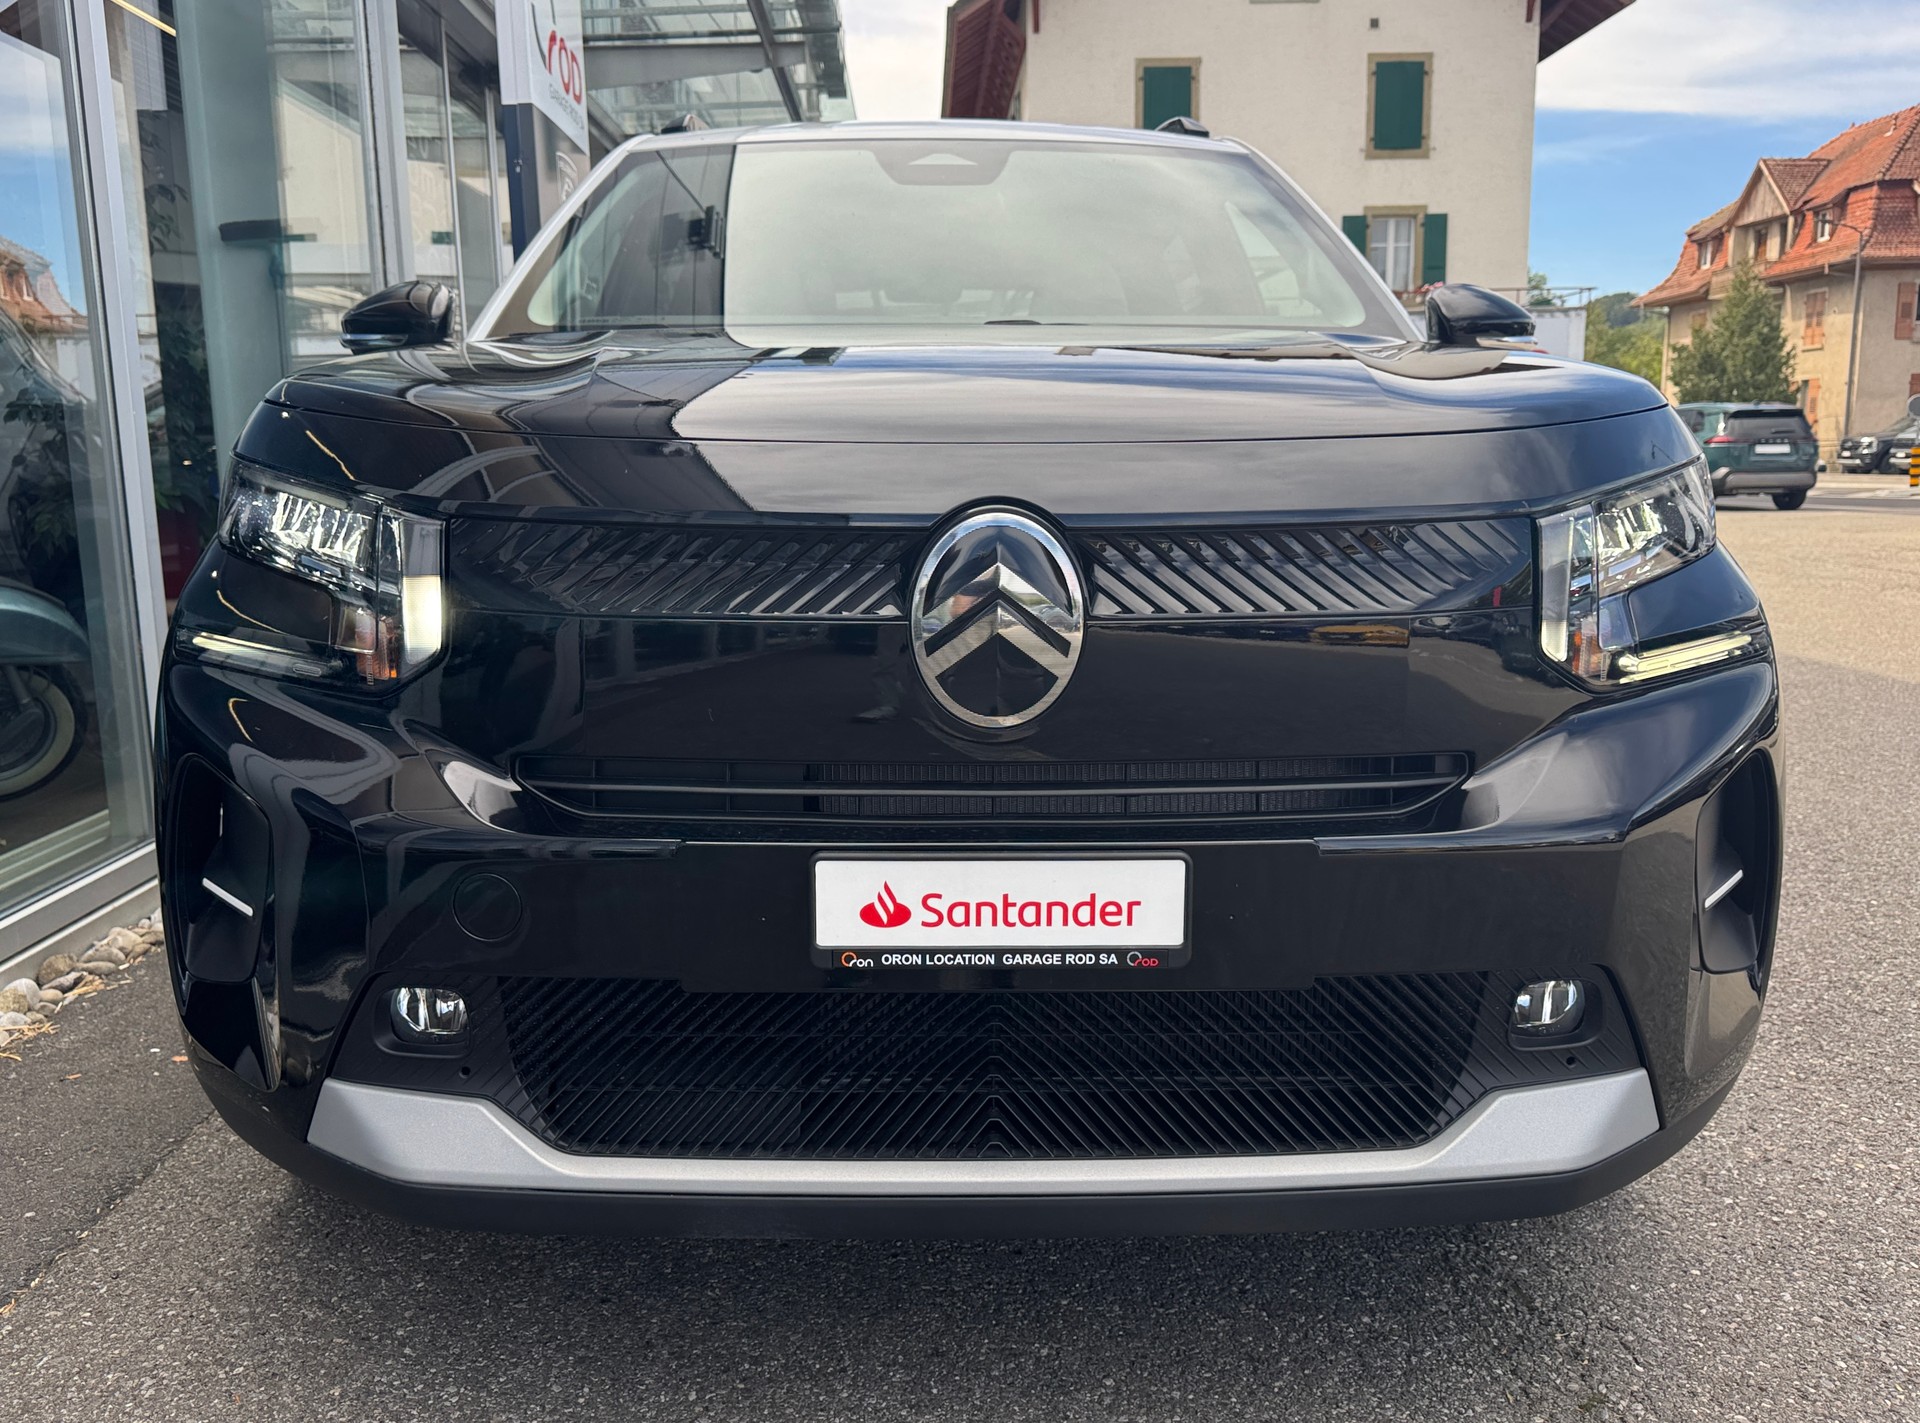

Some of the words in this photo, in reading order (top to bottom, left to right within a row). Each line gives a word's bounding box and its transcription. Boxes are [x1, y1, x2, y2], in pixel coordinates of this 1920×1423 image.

[920, 892, 1142, 928] Santander
[881, 953, 922, 966] ORON
[926, 953, 995, 966] LOCATION
[1002, 953, 1062, 965] GARAGE
[1065, 953, 1096, 965] ROD
[1098, 953, 1119, 965] SA
